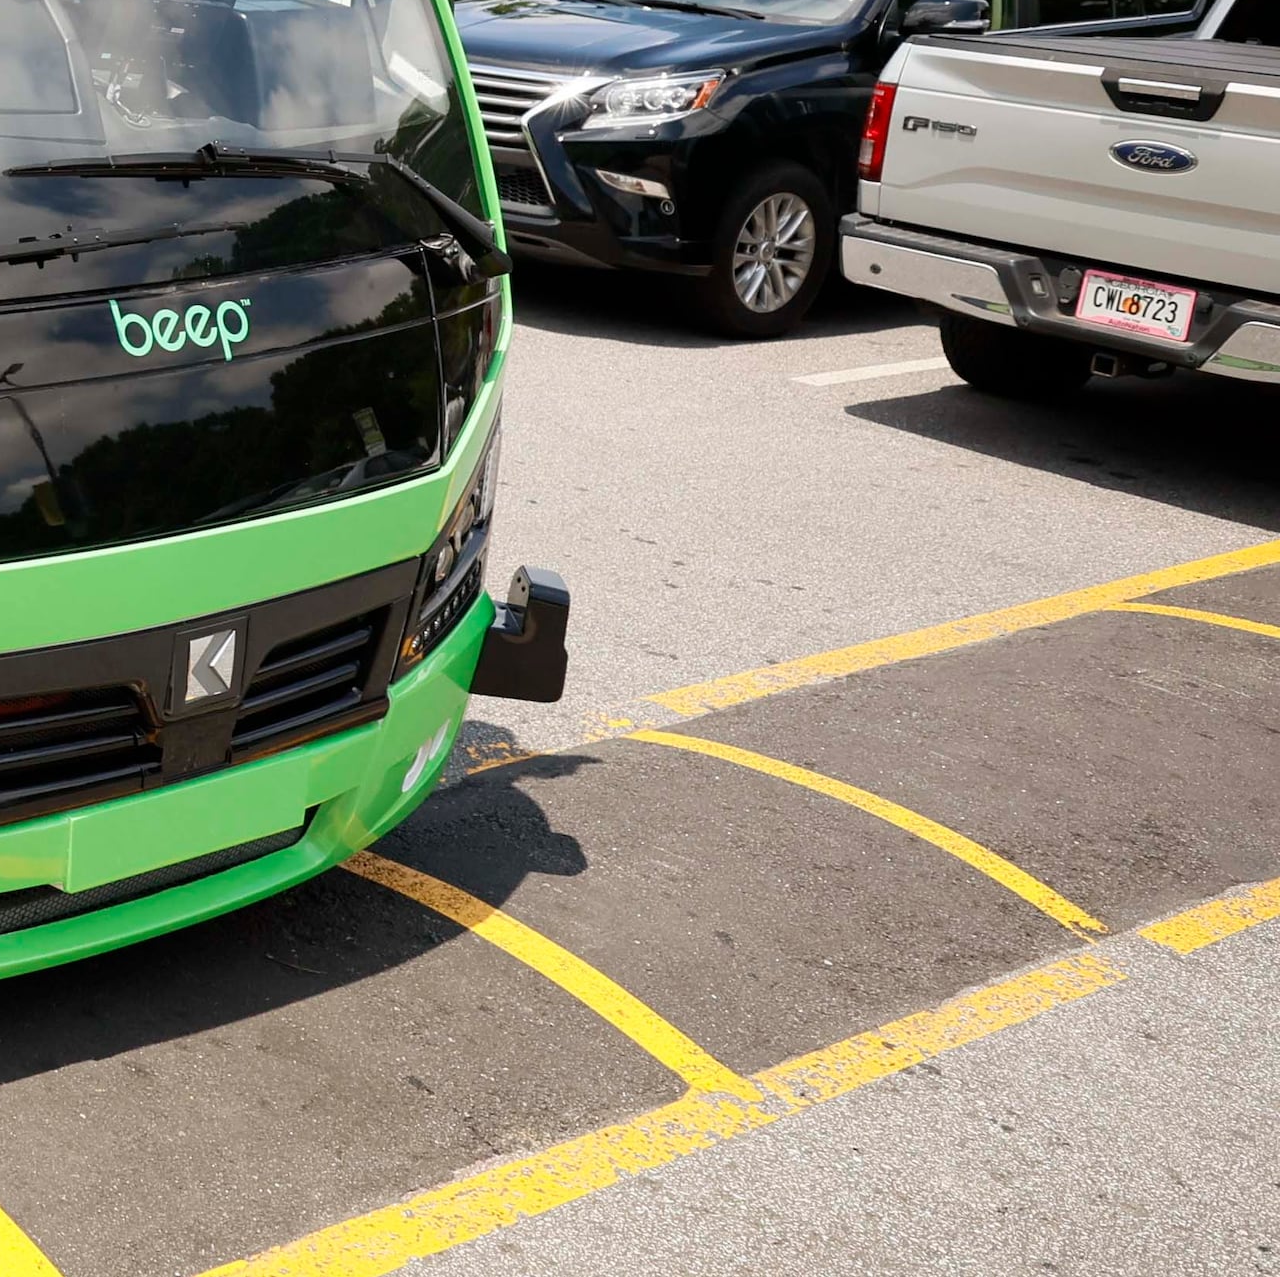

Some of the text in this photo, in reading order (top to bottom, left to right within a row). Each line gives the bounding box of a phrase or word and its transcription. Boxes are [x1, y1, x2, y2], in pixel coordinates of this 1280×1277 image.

[1127, 146, 1177, 168] Ford
[1093, 286, 1179, 323] CWL8723
[108, 299, 249, 361] beep
